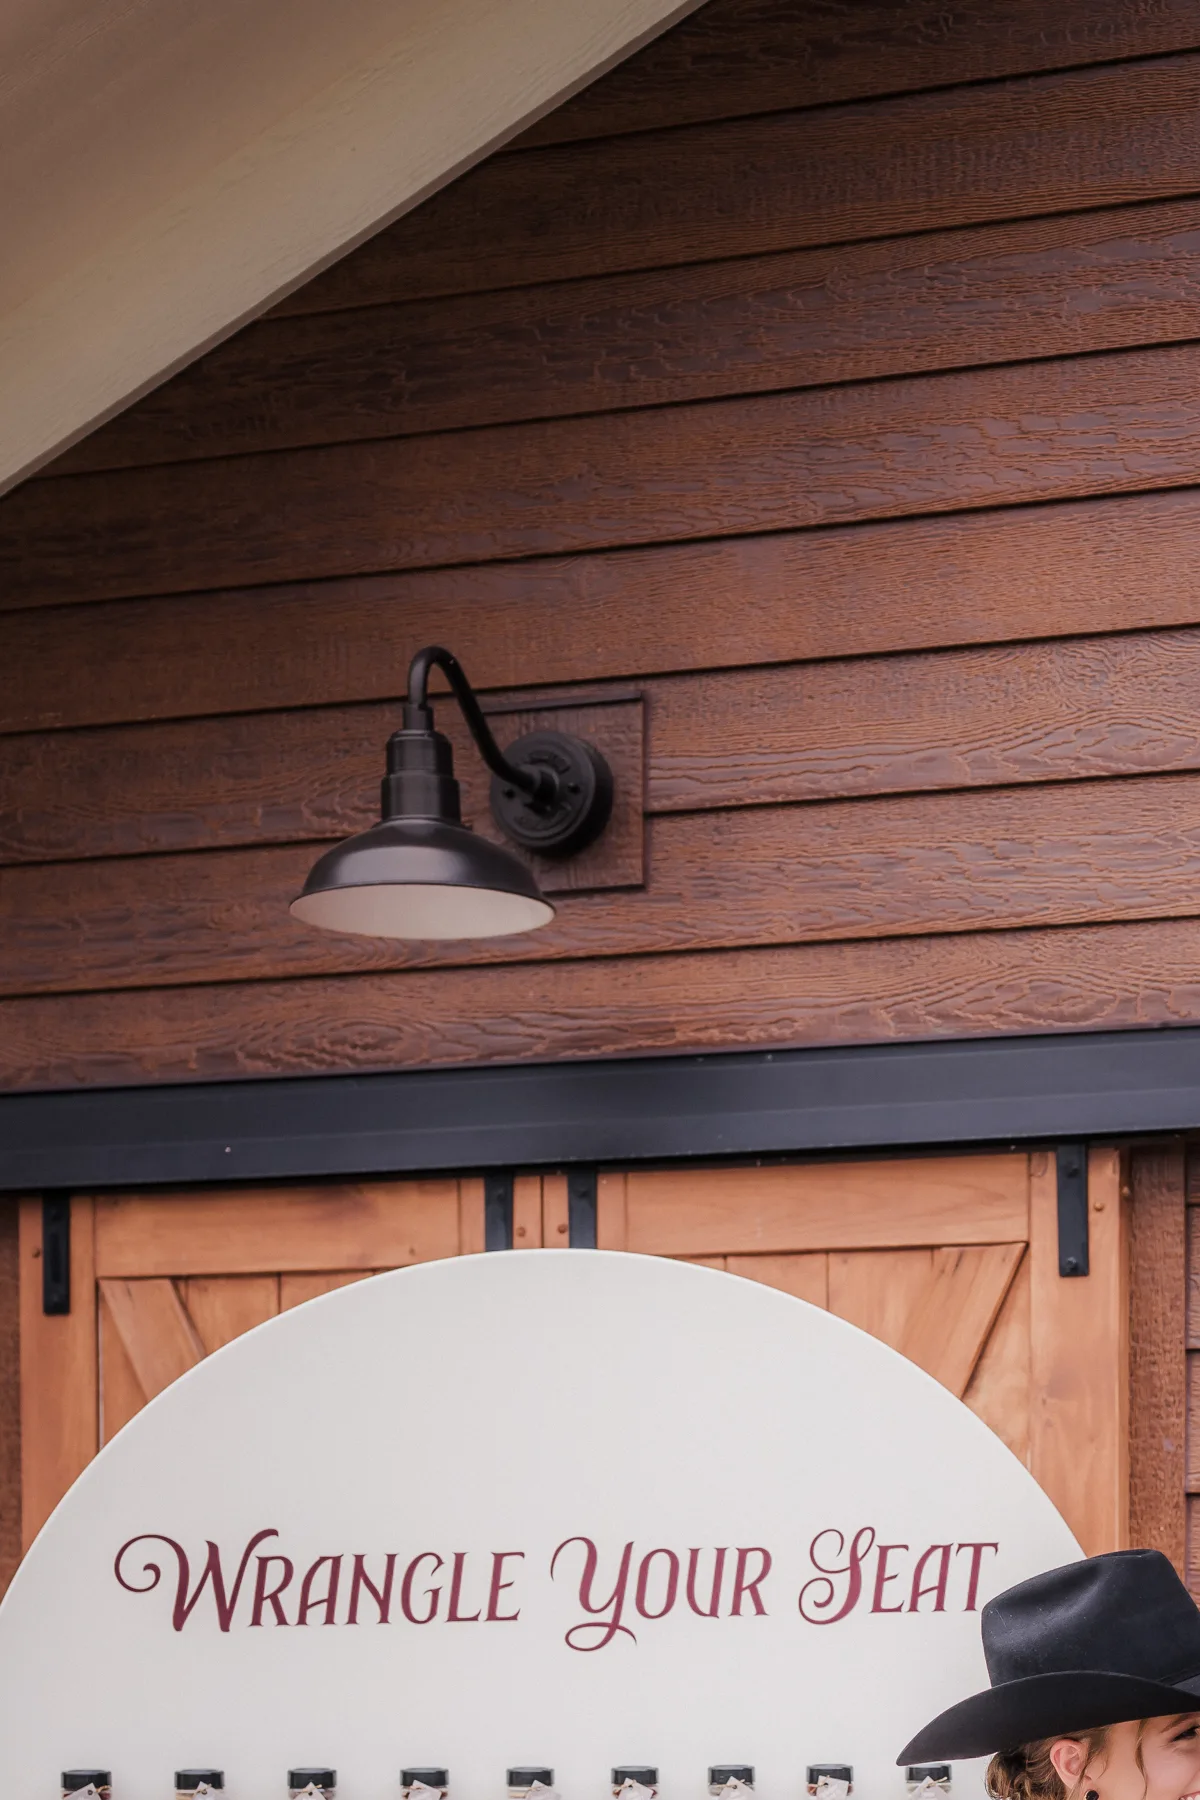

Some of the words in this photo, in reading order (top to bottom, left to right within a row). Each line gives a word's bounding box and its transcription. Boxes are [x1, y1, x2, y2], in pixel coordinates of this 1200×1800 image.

[114, 1528, 525, 1633] WRANGLE
[550, 1536, 772, 1652] YOUR
[798, 1527, 999, 1625] SEAT
